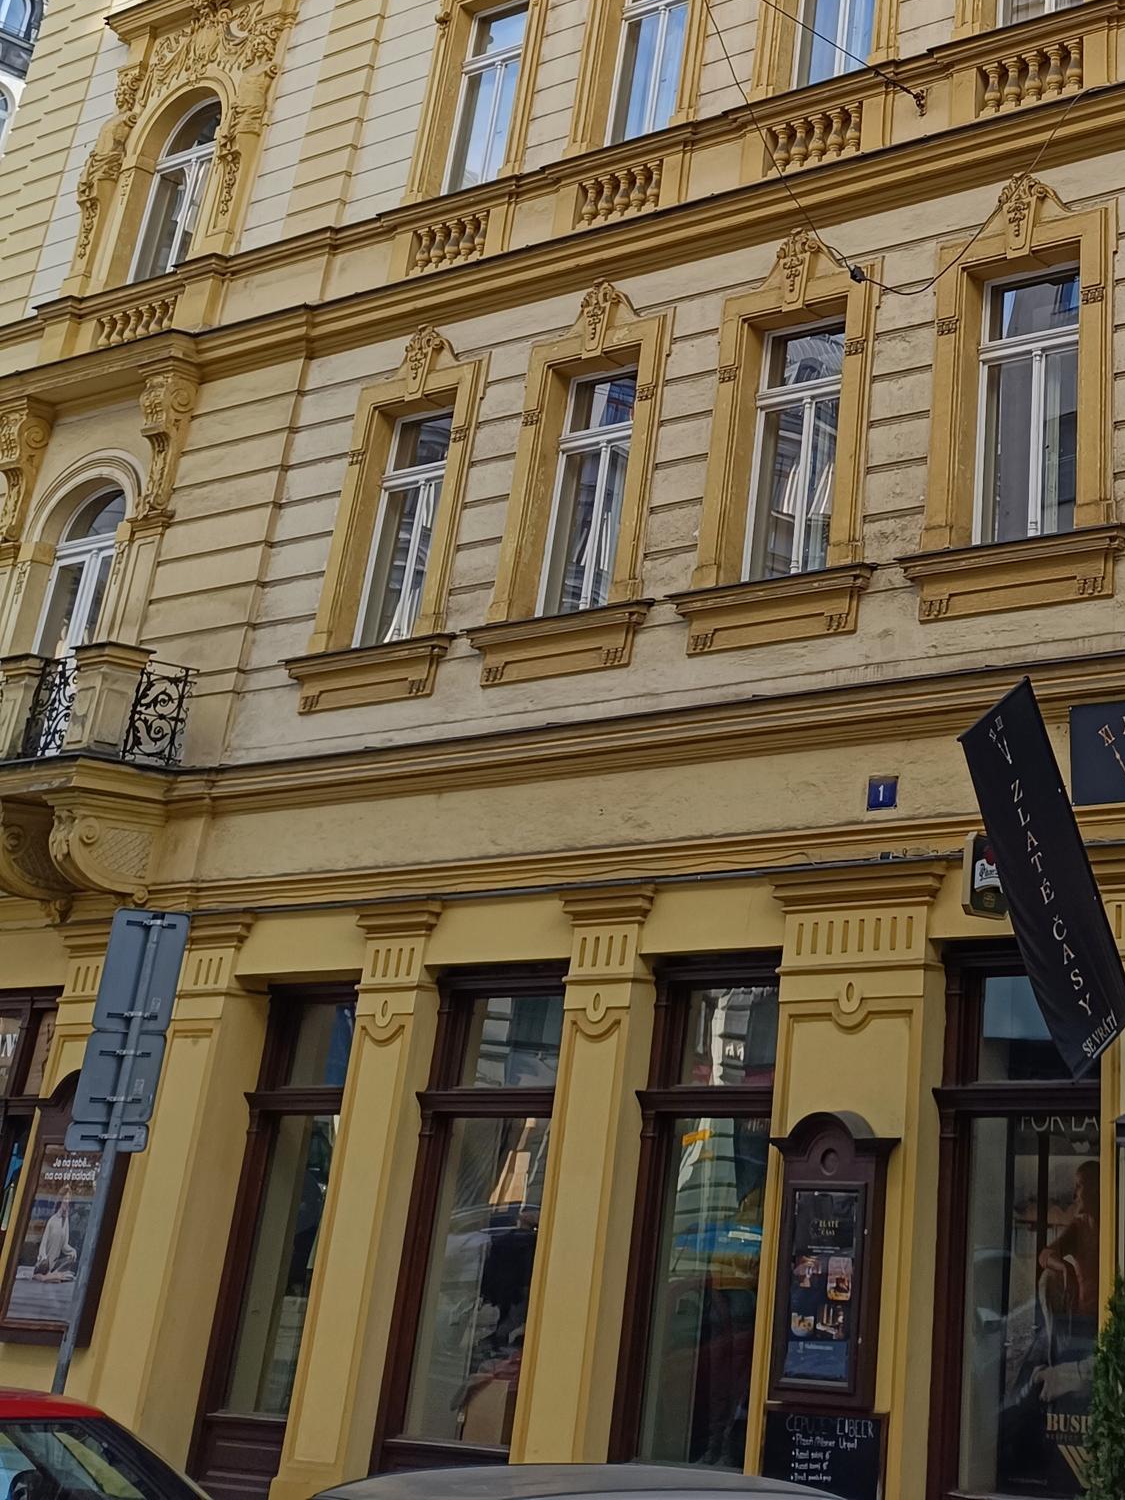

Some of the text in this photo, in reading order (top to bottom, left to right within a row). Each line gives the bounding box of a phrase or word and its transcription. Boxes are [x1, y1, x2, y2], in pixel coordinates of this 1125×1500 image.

[878, 784, 885, 802] 1
[1010, 778, 1092, 1016] ZLATÉ ČASY
